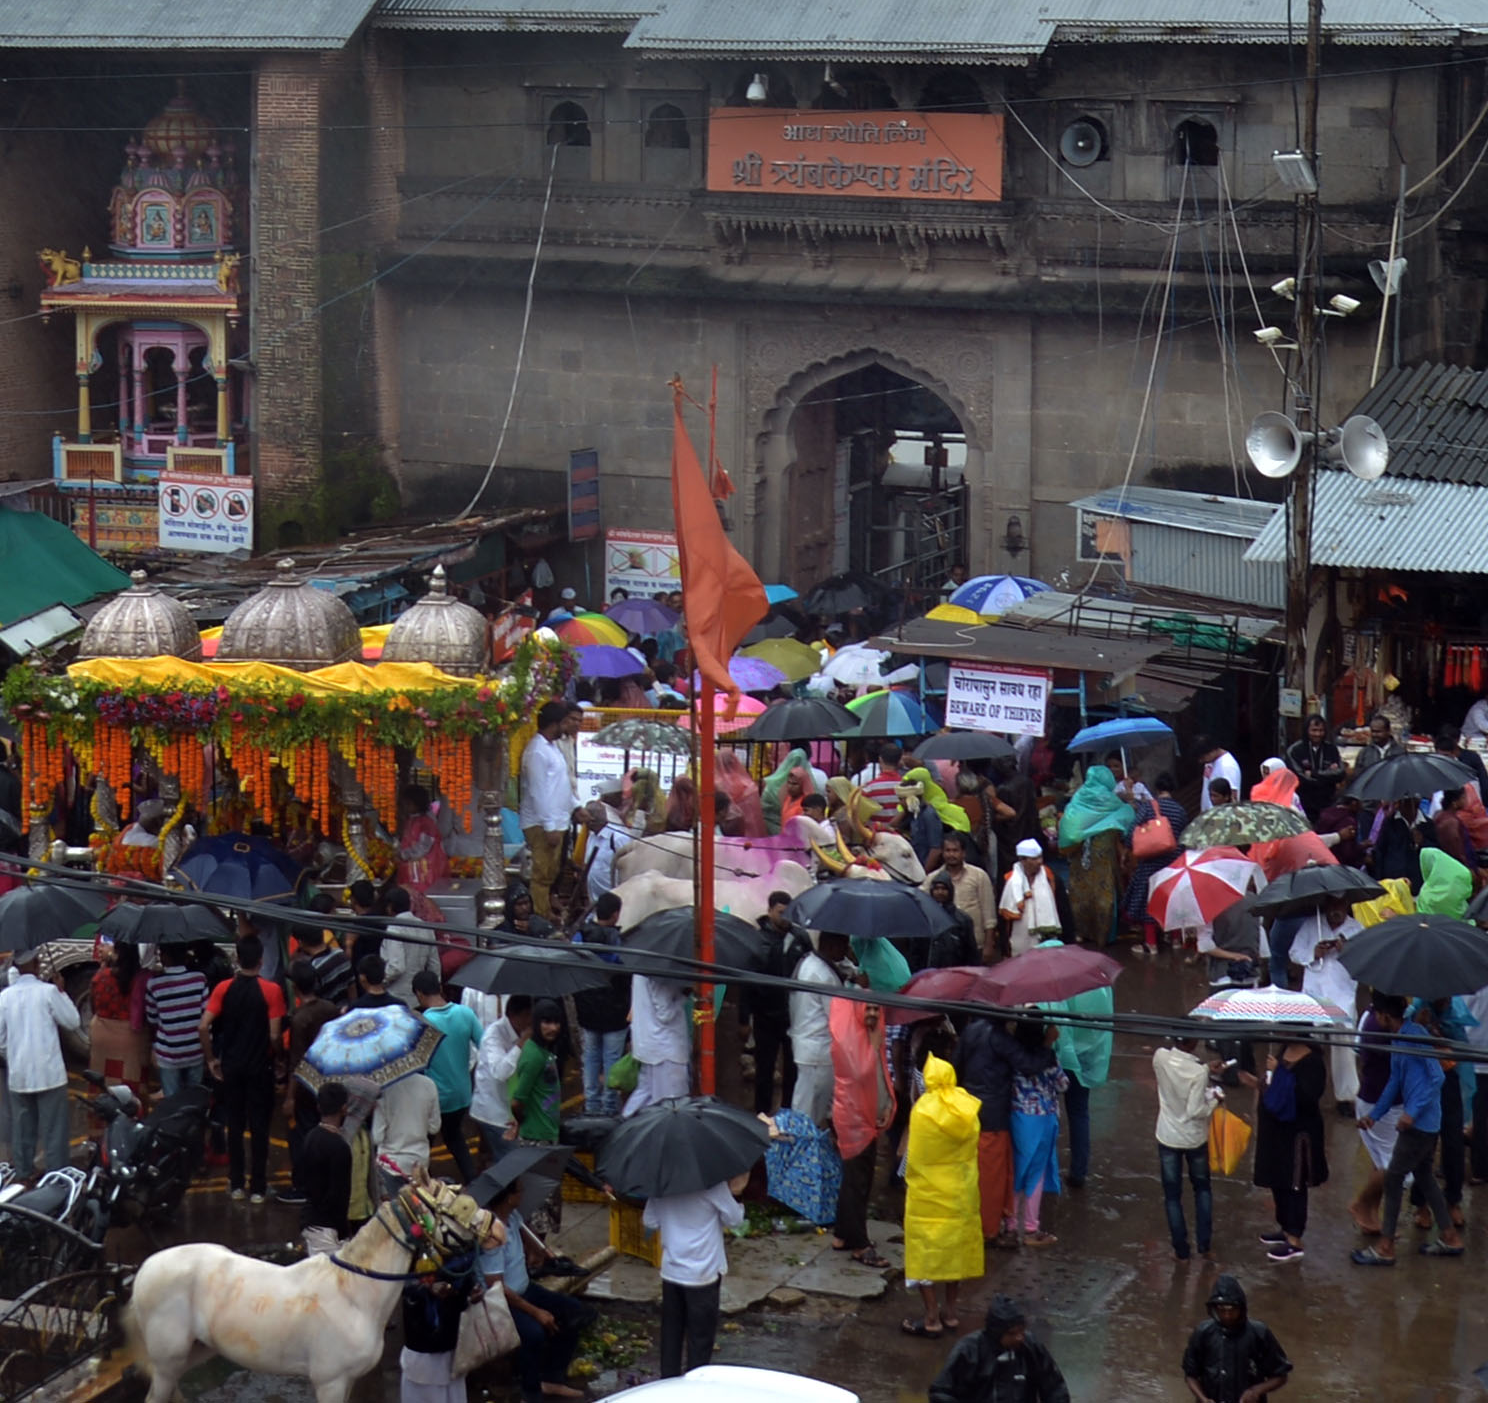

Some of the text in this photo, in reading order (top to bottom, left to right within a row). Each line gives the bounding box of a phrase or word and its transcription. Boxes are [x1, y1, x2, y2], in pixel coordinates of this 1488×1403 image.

[732, 153, 974, 193] श्री त्र्यंबकेश्वर मंदिर
[950, 700, 987, 717] BEWARE
[989, 704, 1002, 719] OF
[1004, 706, 1043, 723] THIEVES
